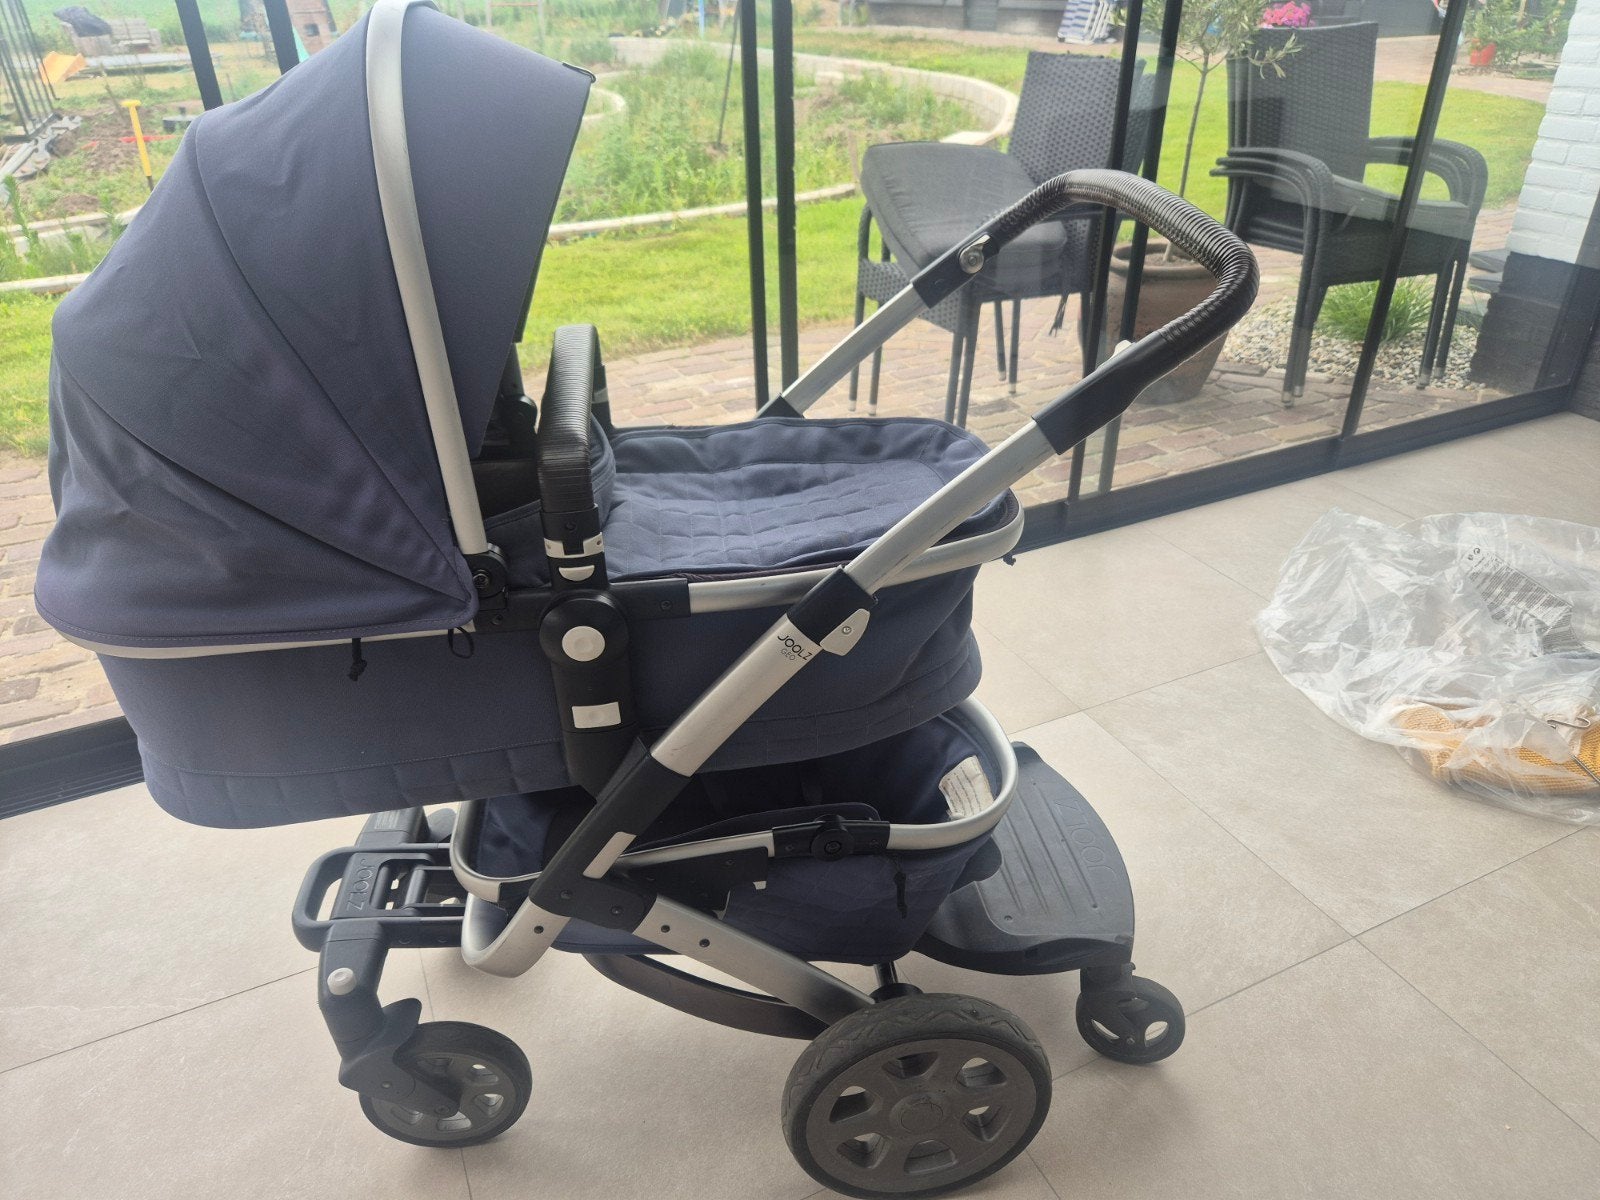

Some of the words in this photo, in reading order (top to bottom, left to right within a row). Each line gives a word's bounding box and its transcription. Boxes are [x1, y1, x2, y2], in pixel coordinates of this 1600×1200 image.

[777, 635, 813, 661] JOOLZ
[1053, 797, 1117, 881] JOOLZ
[346, 858, 376, 911] JOOLZ
